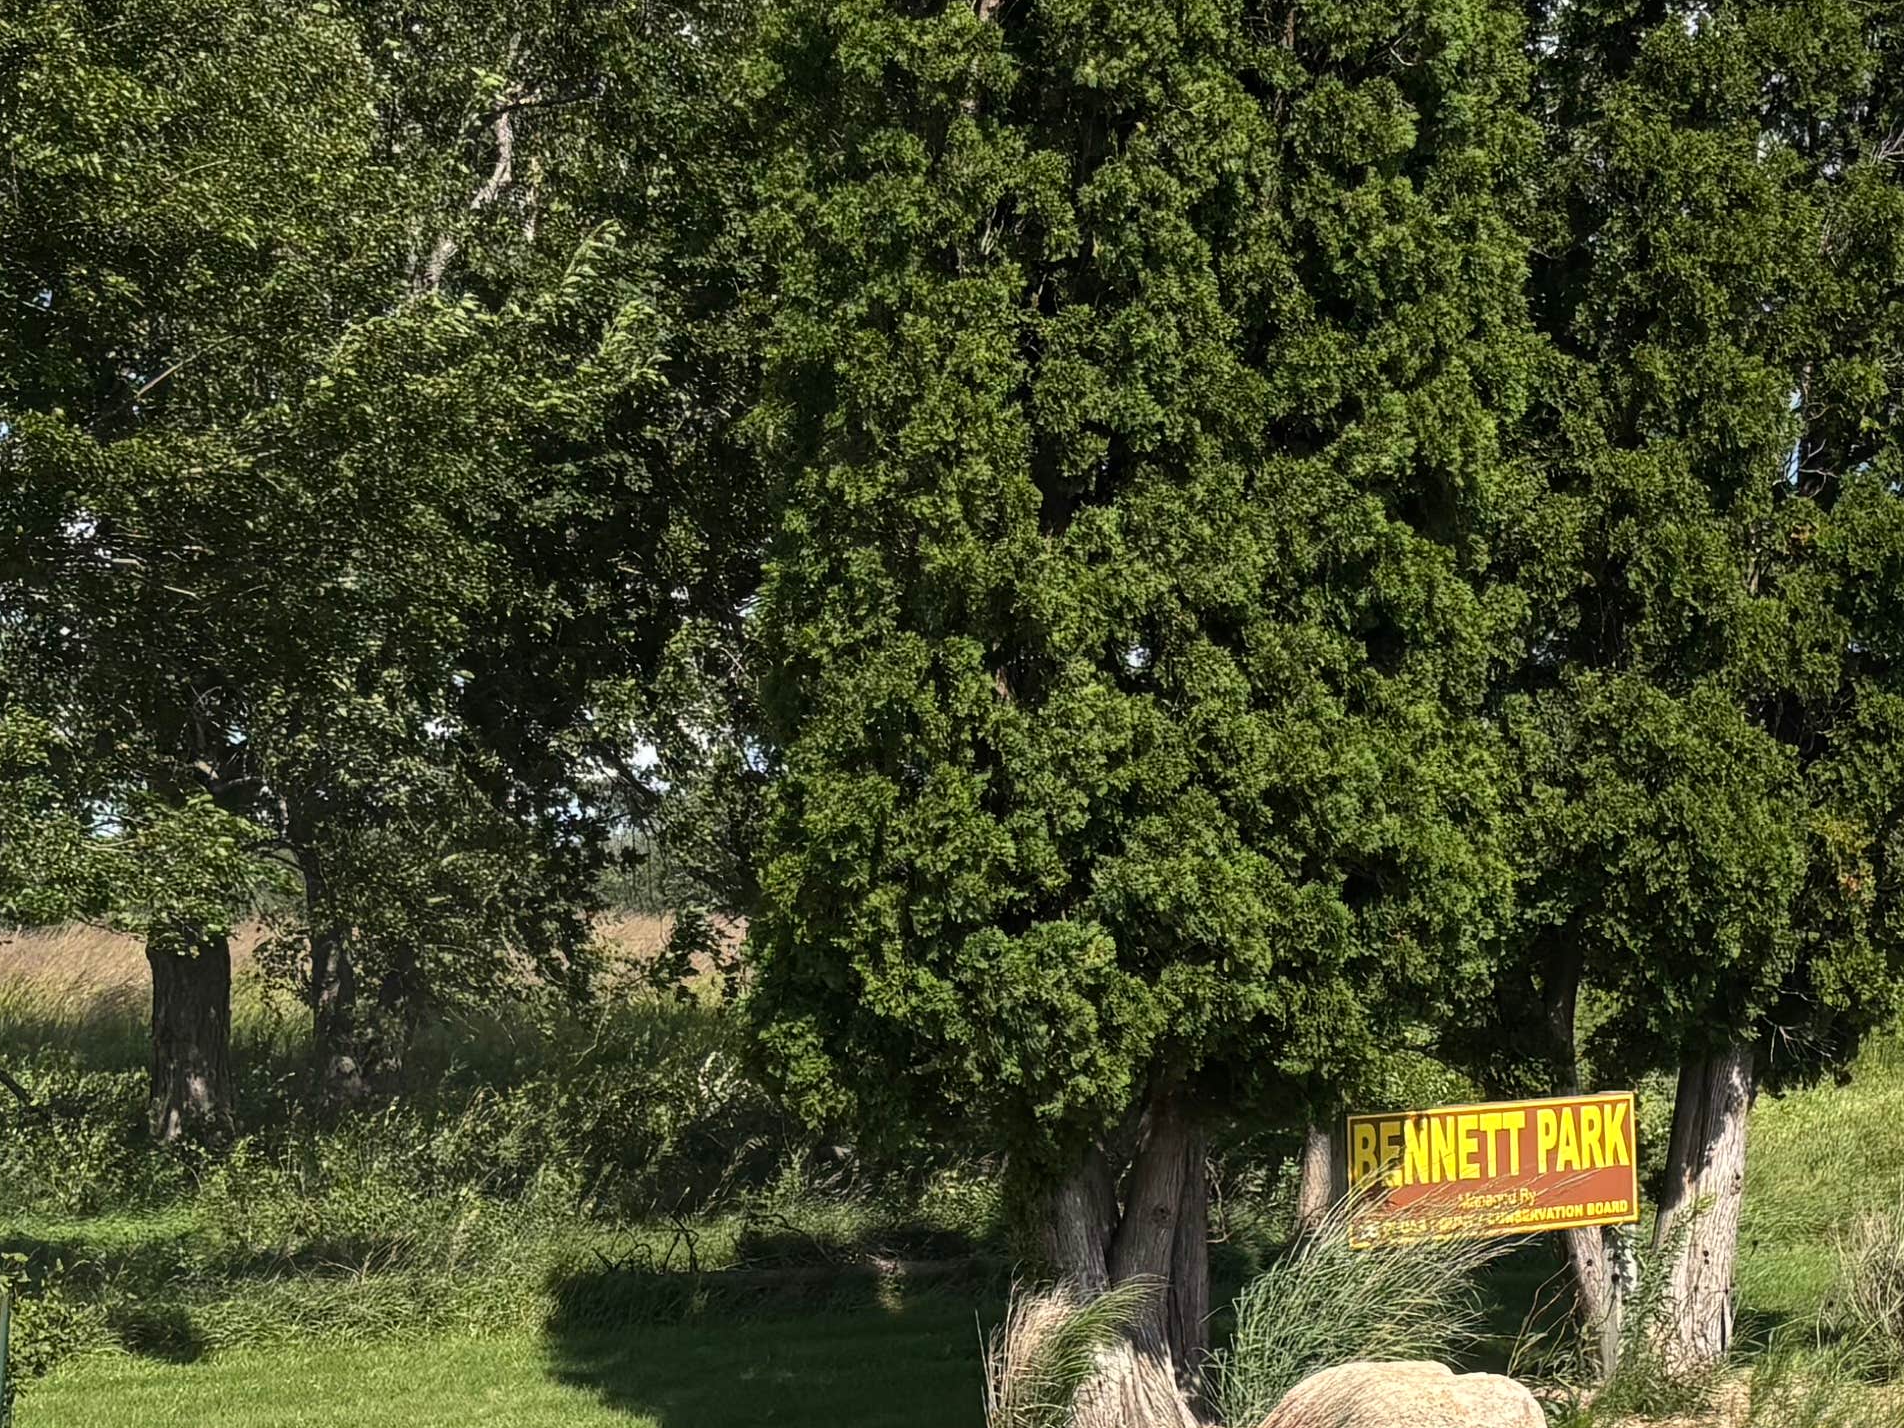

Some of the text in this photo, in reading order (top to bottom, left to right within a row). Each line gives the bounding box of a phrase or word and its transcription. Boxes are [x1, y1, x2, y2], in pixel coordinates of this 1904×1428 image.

[1353, 1103, 1629, 1189] BENNETT PARK
[1520, 1187, 1537, 1206] By
[1587, 1200, 1628, 1215] BOARD
